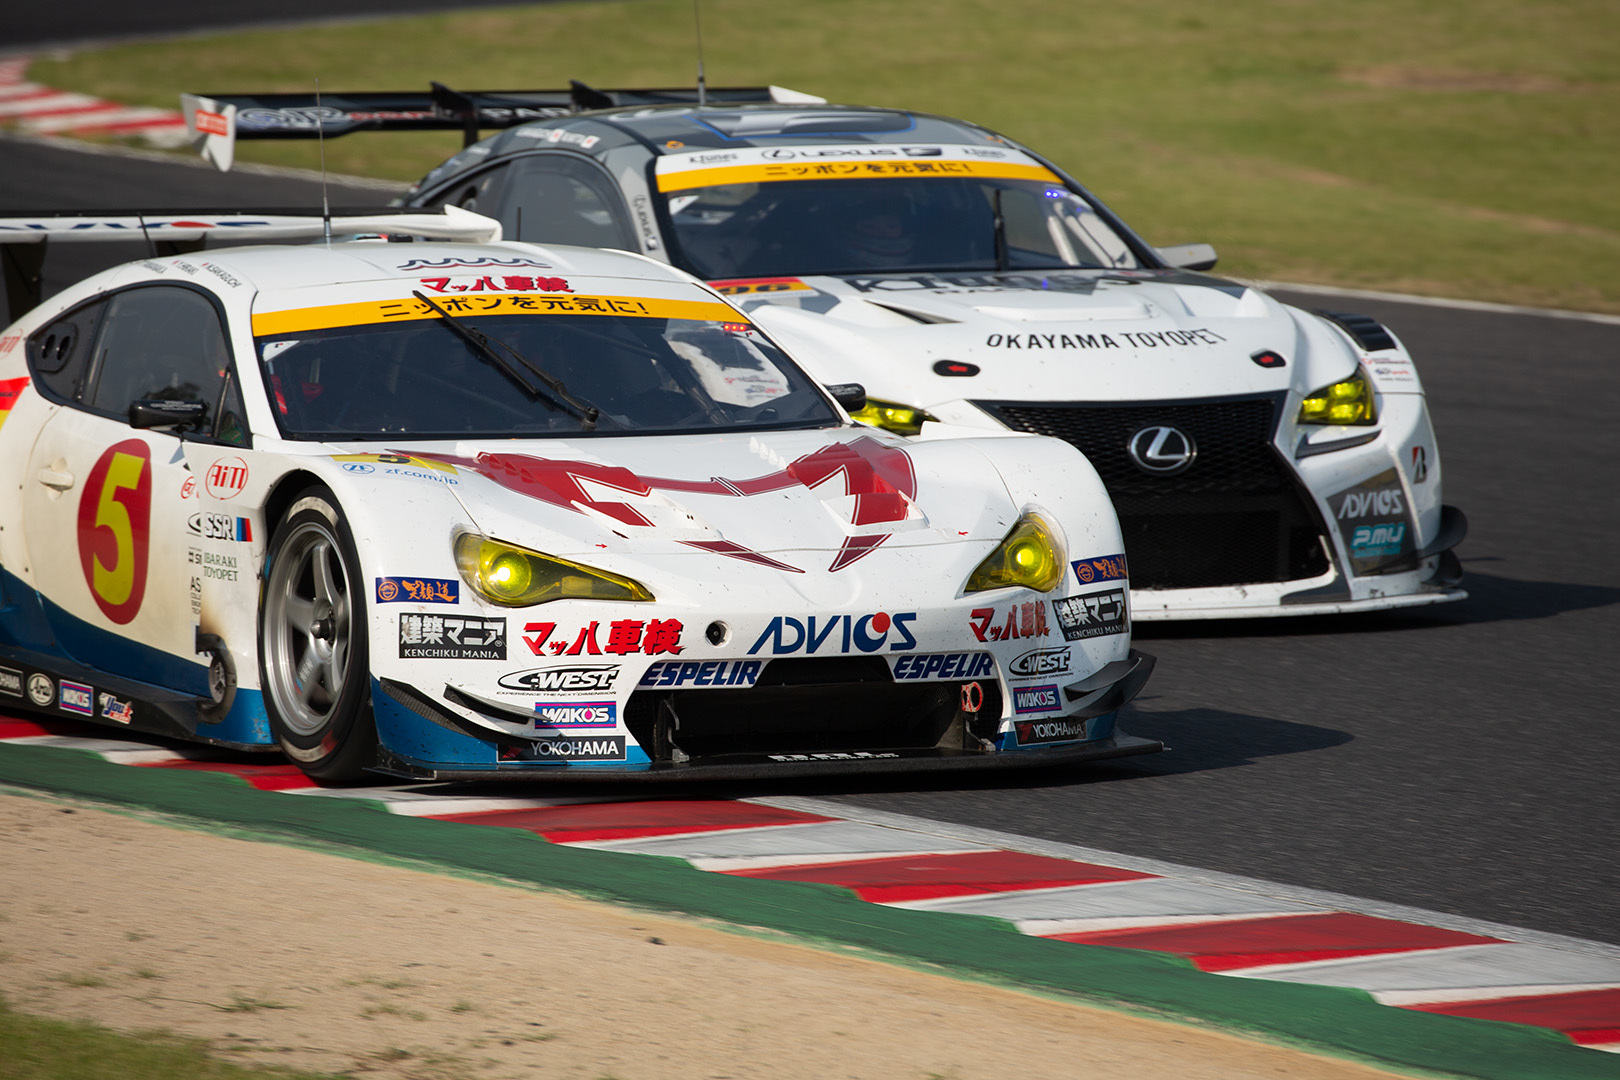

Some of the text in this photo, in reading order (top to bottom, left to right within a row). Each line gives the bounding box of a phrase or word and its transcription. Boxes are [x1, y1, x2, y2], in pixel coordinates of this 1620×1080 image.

[801, 149, 897, 158] LEXUS
[765, 162, 974, 176] ニッポンを元気に!
[420, 276, 575, 293] マッハ車検
[379, 295, 651, 319] ニッポンを元気に!
[986, 328, 1228, 349] OKAYAMA TOYOPET
[385, 468, 459, 487] zf.com/jp
[1338, 488, 1404, 520] ADVICS
[93, 451, 146, 606] 5
[204, 511, 235, 542] SSR
[203, 551, 238, 569] IBARAKI
[202, 565, 239, 582] TOYOPET
[968, 600, 1051, 643] マッハ車検
[1053, 592, 1125, 630] 建築マニア
[400, 614, 506, 646] 建築マニア
[521, 617, 688, 657] マッハ車検
[746, 611, 918, 655] ADVICS
[1067, 626, 1105, 641] KENCHIKU
[404, 648, 500, 659] KENCHIKU MANIA
[638, 660, 763, 687] ESPELIR
[892, 652, 995, 680] ESPELIR
[1032, 721, 1084, 739] YOKOHAMA
[530, 740, 619, 756] YOKOHAMA
